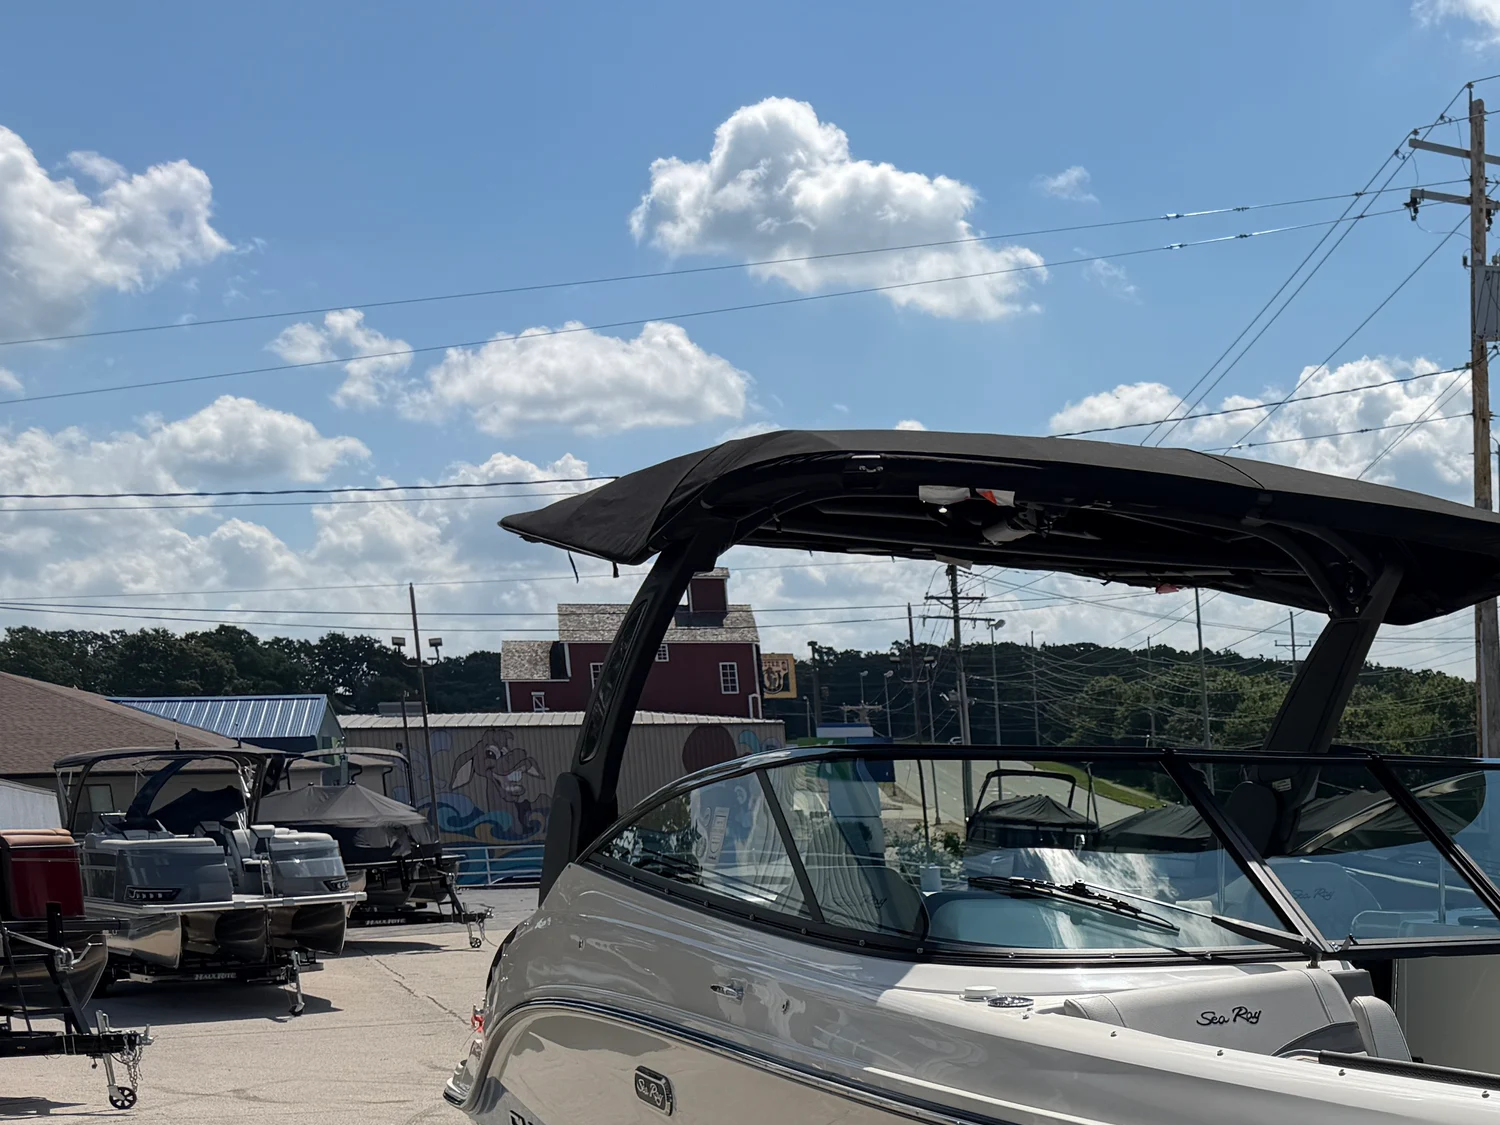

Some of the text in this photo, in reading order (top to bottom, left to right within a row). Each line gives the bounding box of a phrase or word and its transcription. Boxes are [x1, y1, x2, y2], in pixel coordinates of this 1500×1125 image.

[1196, 1006, 1261, 1026] Sea Ray
[637, 1078, 664, 1106] Sea Ray
